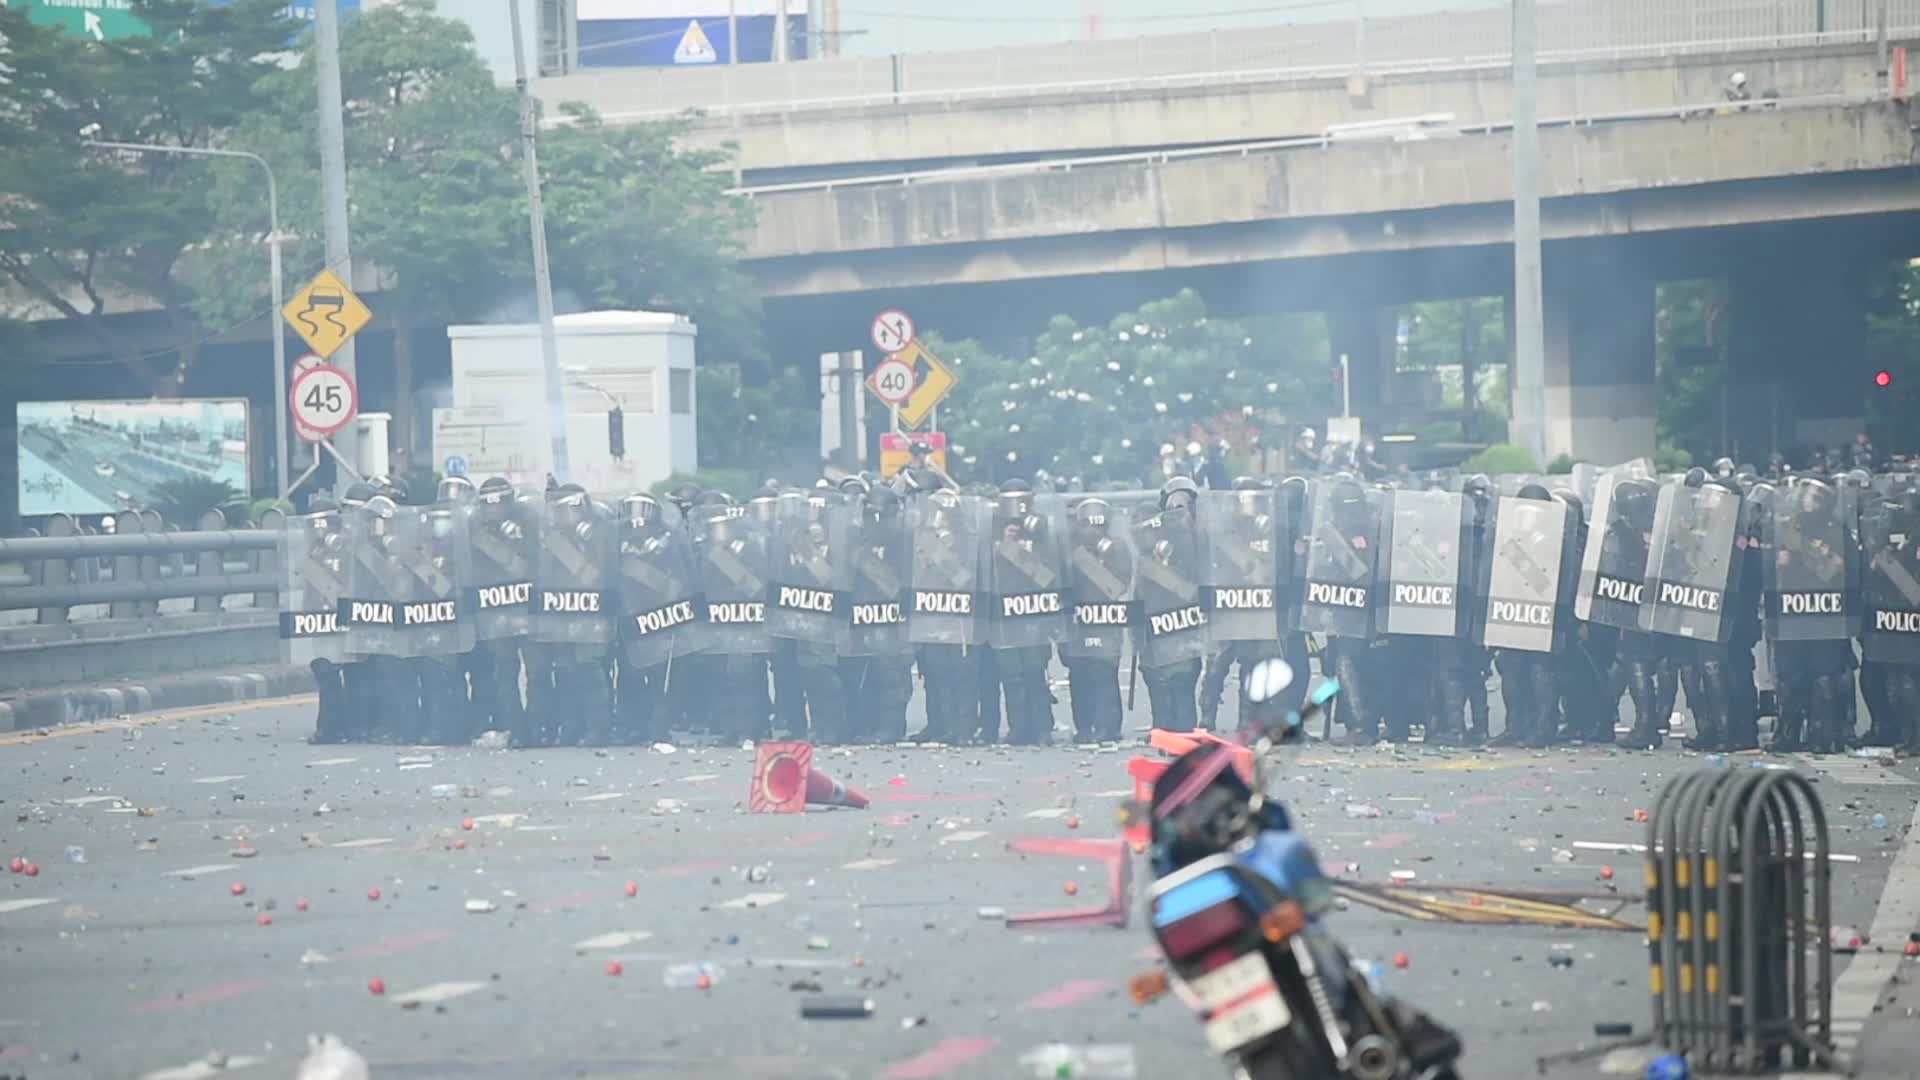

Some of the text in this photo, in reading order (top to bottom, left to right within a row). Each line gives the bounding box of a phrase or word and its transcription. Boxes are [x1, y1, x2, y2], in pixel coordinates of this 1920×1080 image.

[881, 373, 906, 391] 40
[303, 384, 342, 413] 45
[779, 587, 834, 612] POLICE
[1215, 589, 1272, 608] POLICE
[1308, 583, 1366, 608] POLICE
[1395, 585, 1452, 605] POLICE
[1597, 577, 1643, 604] POLIC
[1660, 583, 1719, 610] POLICE
[352, 602, 394, 624] POLI
[404, 601, 456, 624] POLICE
[543, 592, 600, 612] POLICE
[708, 603, 765, 623] POLICE
[915, 592, 971, 613] POLICE
[1003, 593, 1060, 616] POLICE
[1492, 602, 1551, 624] POLICE
[1782, 593, 1842, 613] POLICE
[295, 613, 350, 634] POLIC
[637, 601, 695, 635] POLICE
[1072, 605, 1127, 624] POLICE
[1151, 606, 1208, 635] POLICE
[1876, 610, 1920, 632] POLIC
